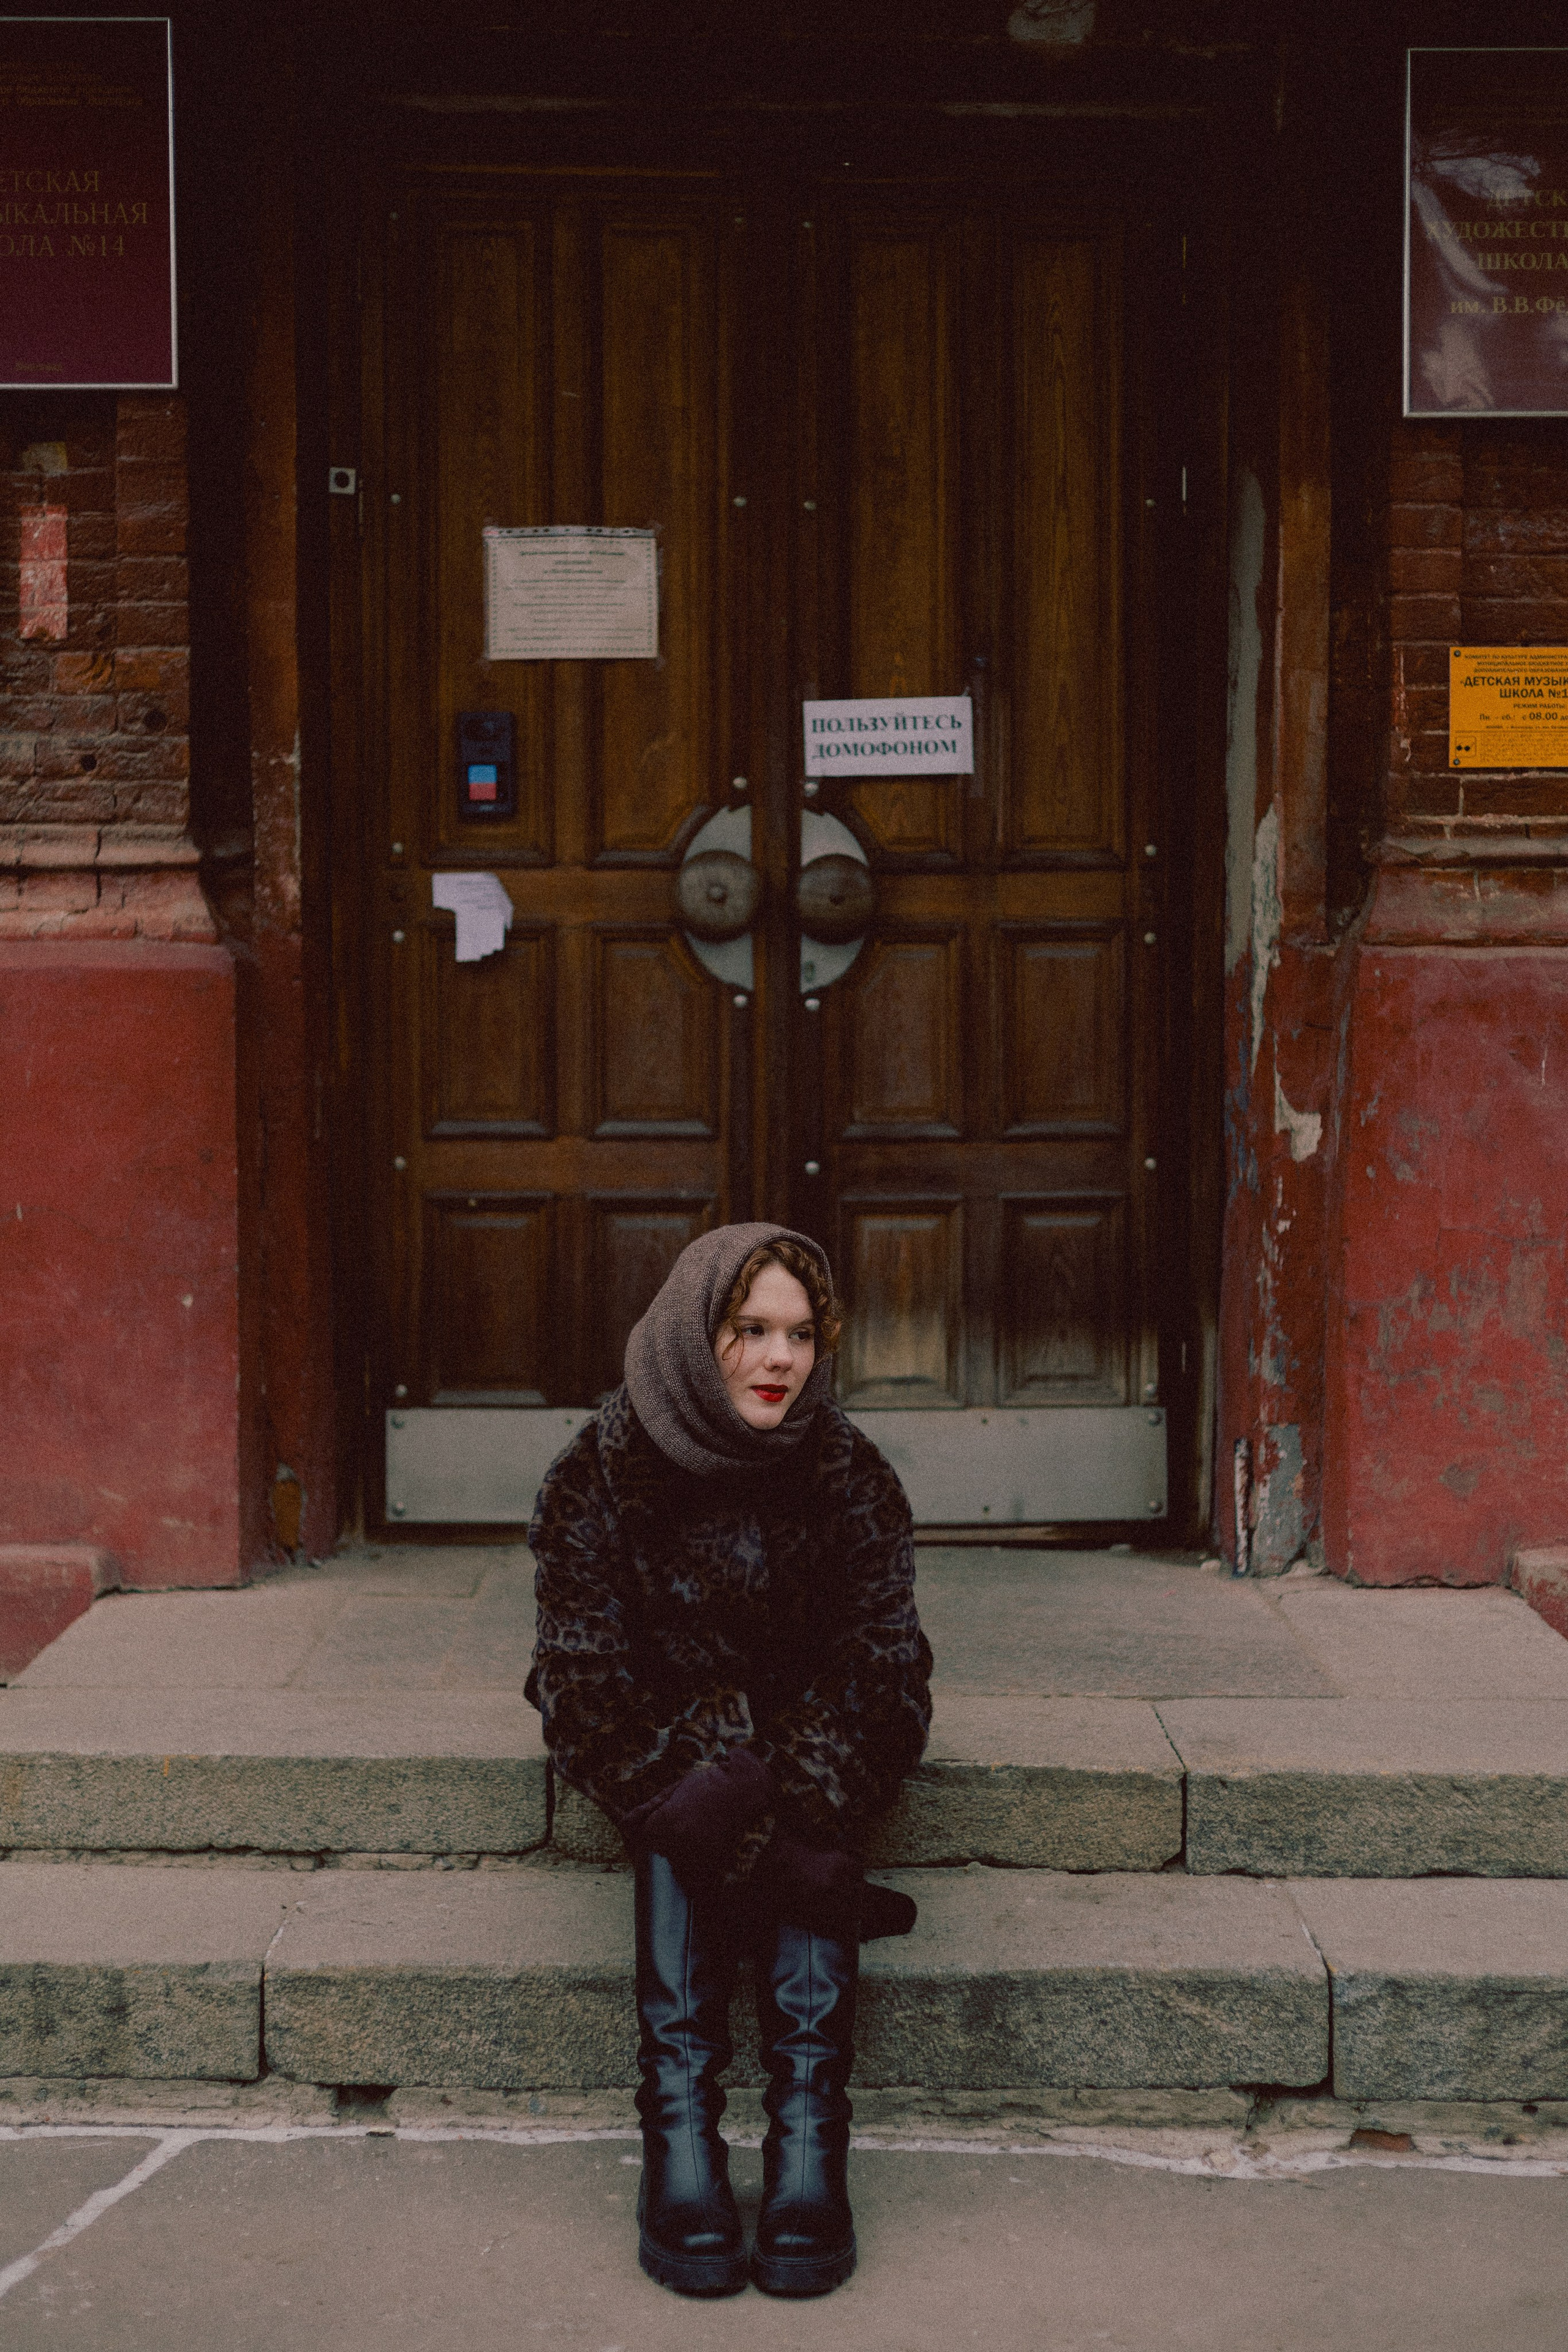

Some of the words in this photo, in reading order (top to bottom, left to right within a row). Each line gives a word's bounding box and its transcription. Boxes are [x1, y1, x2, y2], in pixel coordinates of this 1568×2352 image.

[0, 234, 55, 257] ОЛА
[67, 234, 125, 257] №14
[1477, 252, 1568, 270] ШКОЛА
[1450, 301, 1486, 314] им.
[1492, 296, 1568, 314] В.В.Фё
[1499, 688, 1544, 698] ШКОЛА
[812, 712, 963, 733] ПОЛЬЗУЙТЕСЬ
[1529, 712, 1558, 720] 08.00
[812, 739, 957, 760] ДОМОФОНОМ
